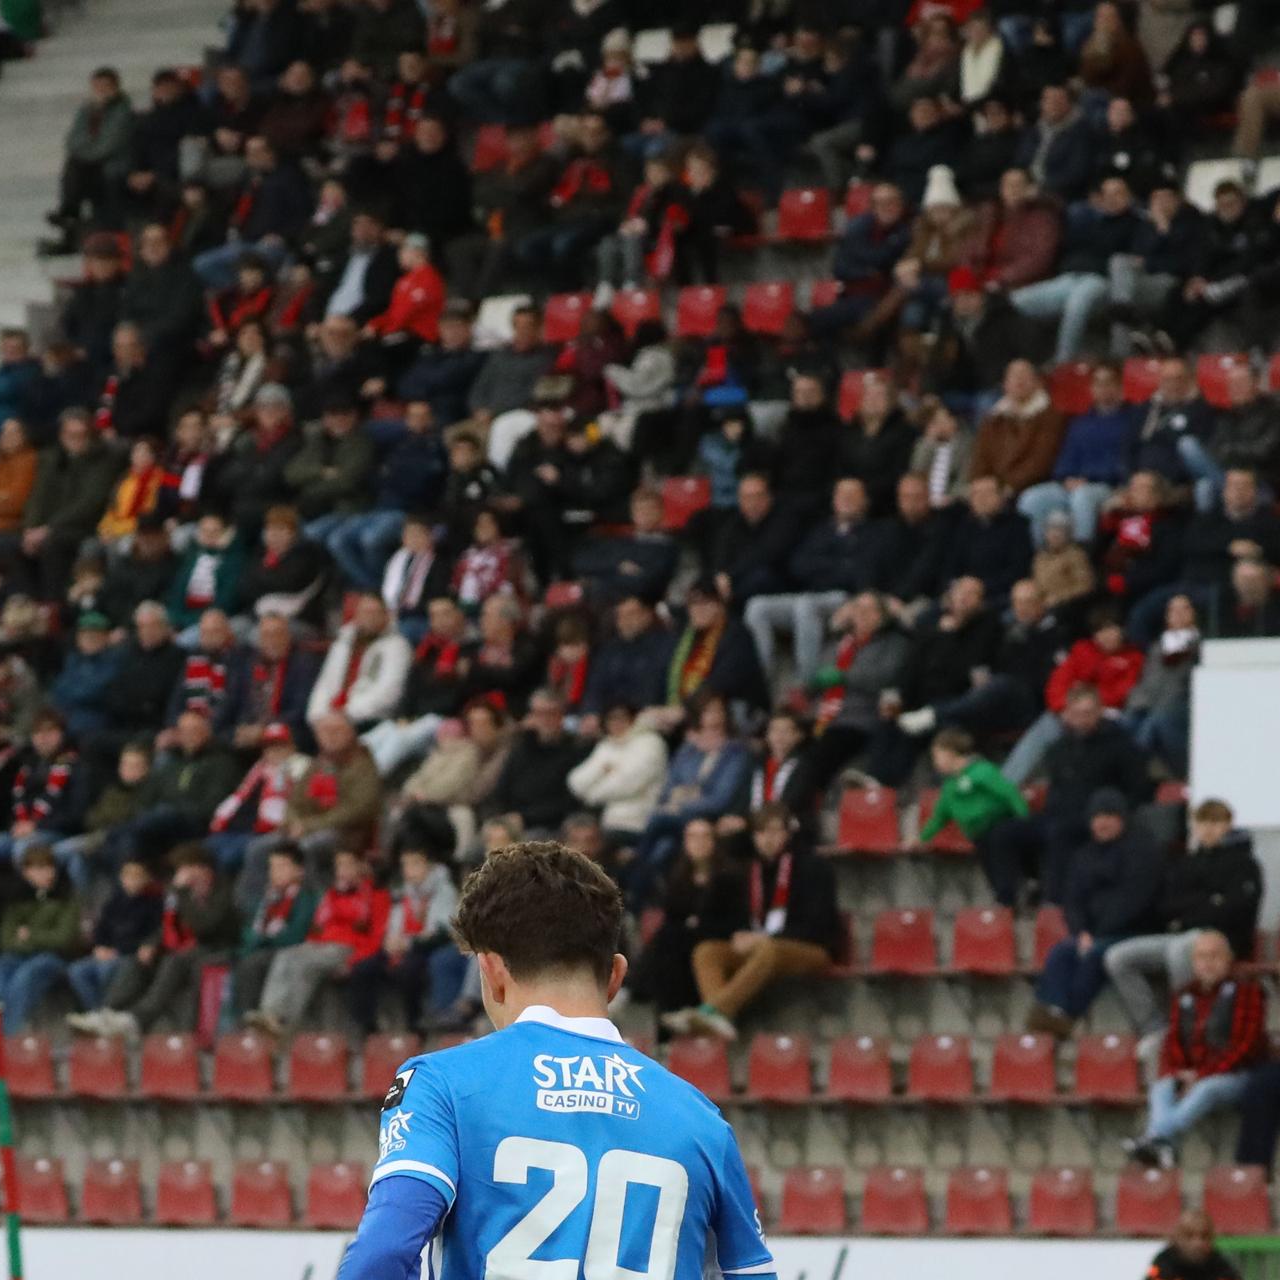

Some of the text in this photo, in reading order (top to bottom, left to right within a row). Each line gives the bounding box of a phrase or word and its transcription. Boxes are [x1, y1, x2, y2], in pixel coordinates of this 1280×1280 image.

[532, 1053, 646, 1097] STAR
[543, 1094, 636, 1115] CASINO TV
